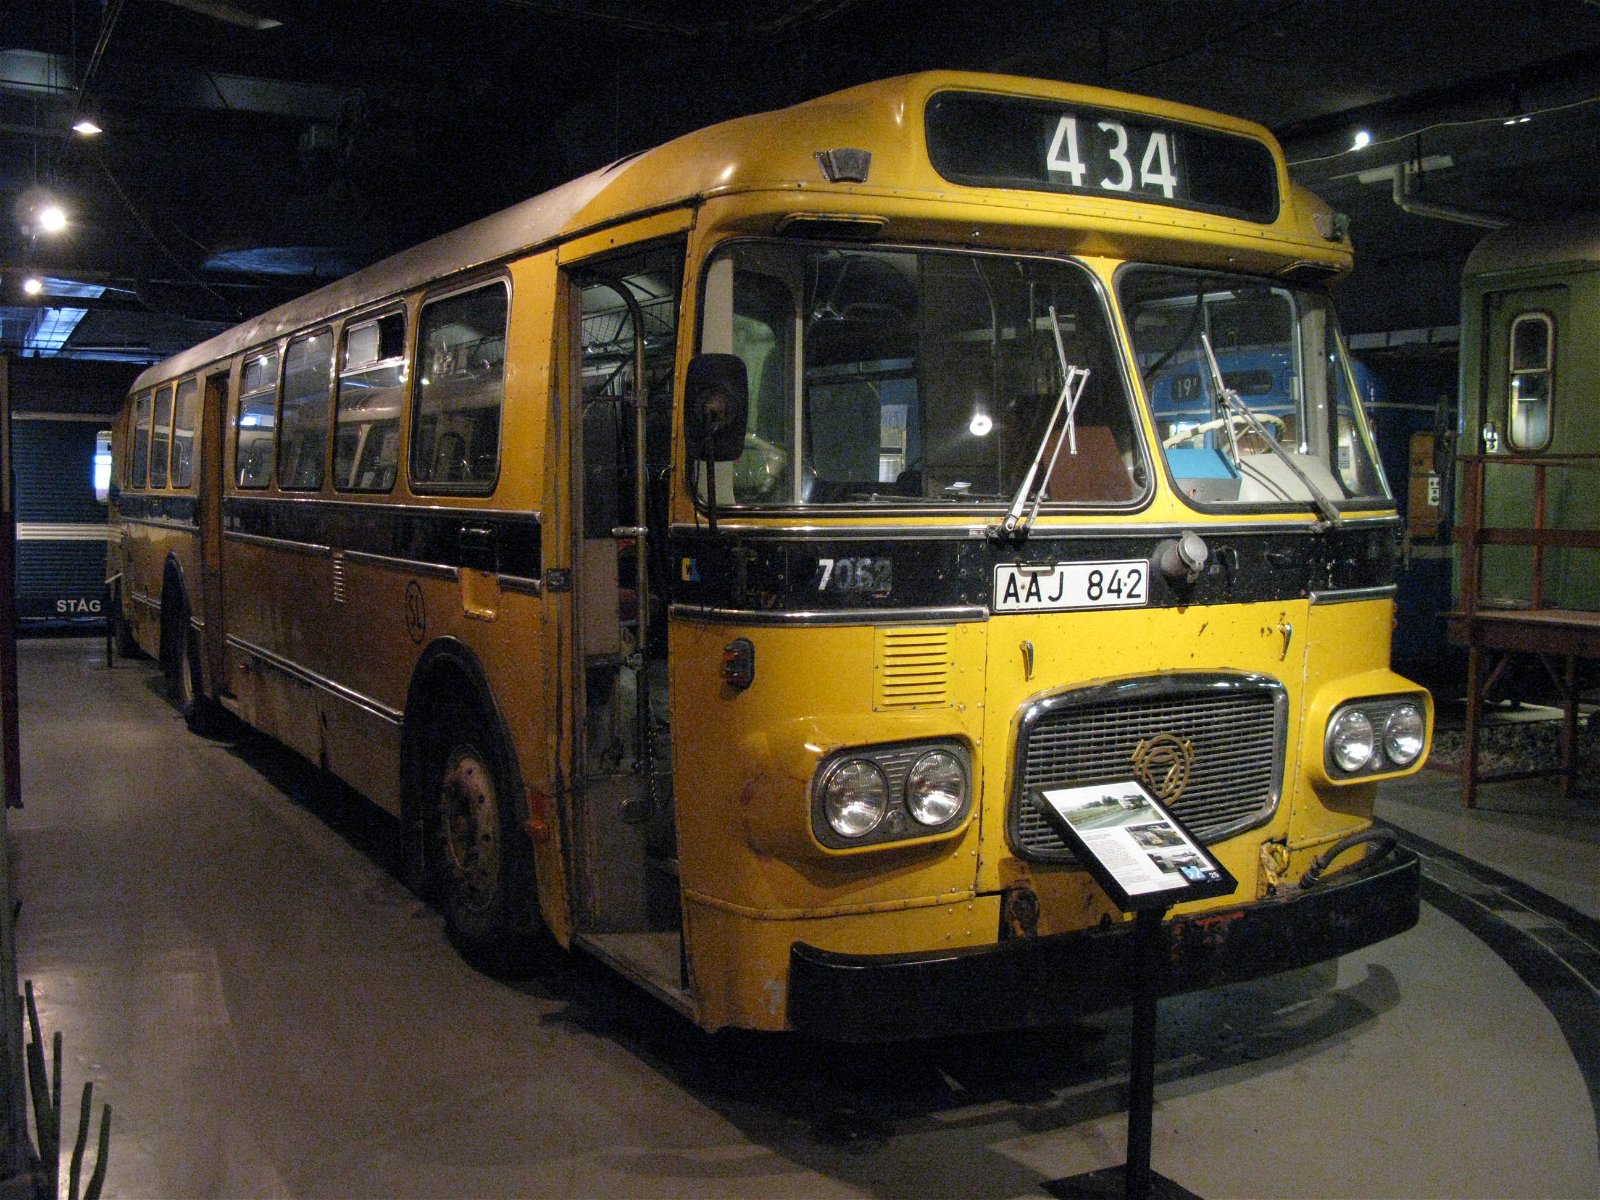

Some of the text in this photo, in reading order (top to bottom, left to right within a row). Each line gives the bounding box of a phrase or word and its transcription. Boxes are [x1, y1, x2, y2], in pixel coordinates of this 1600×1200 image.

[1046, 115, 1177, 199] 434
[1003, 568, 1143, 604] AAJ 842
